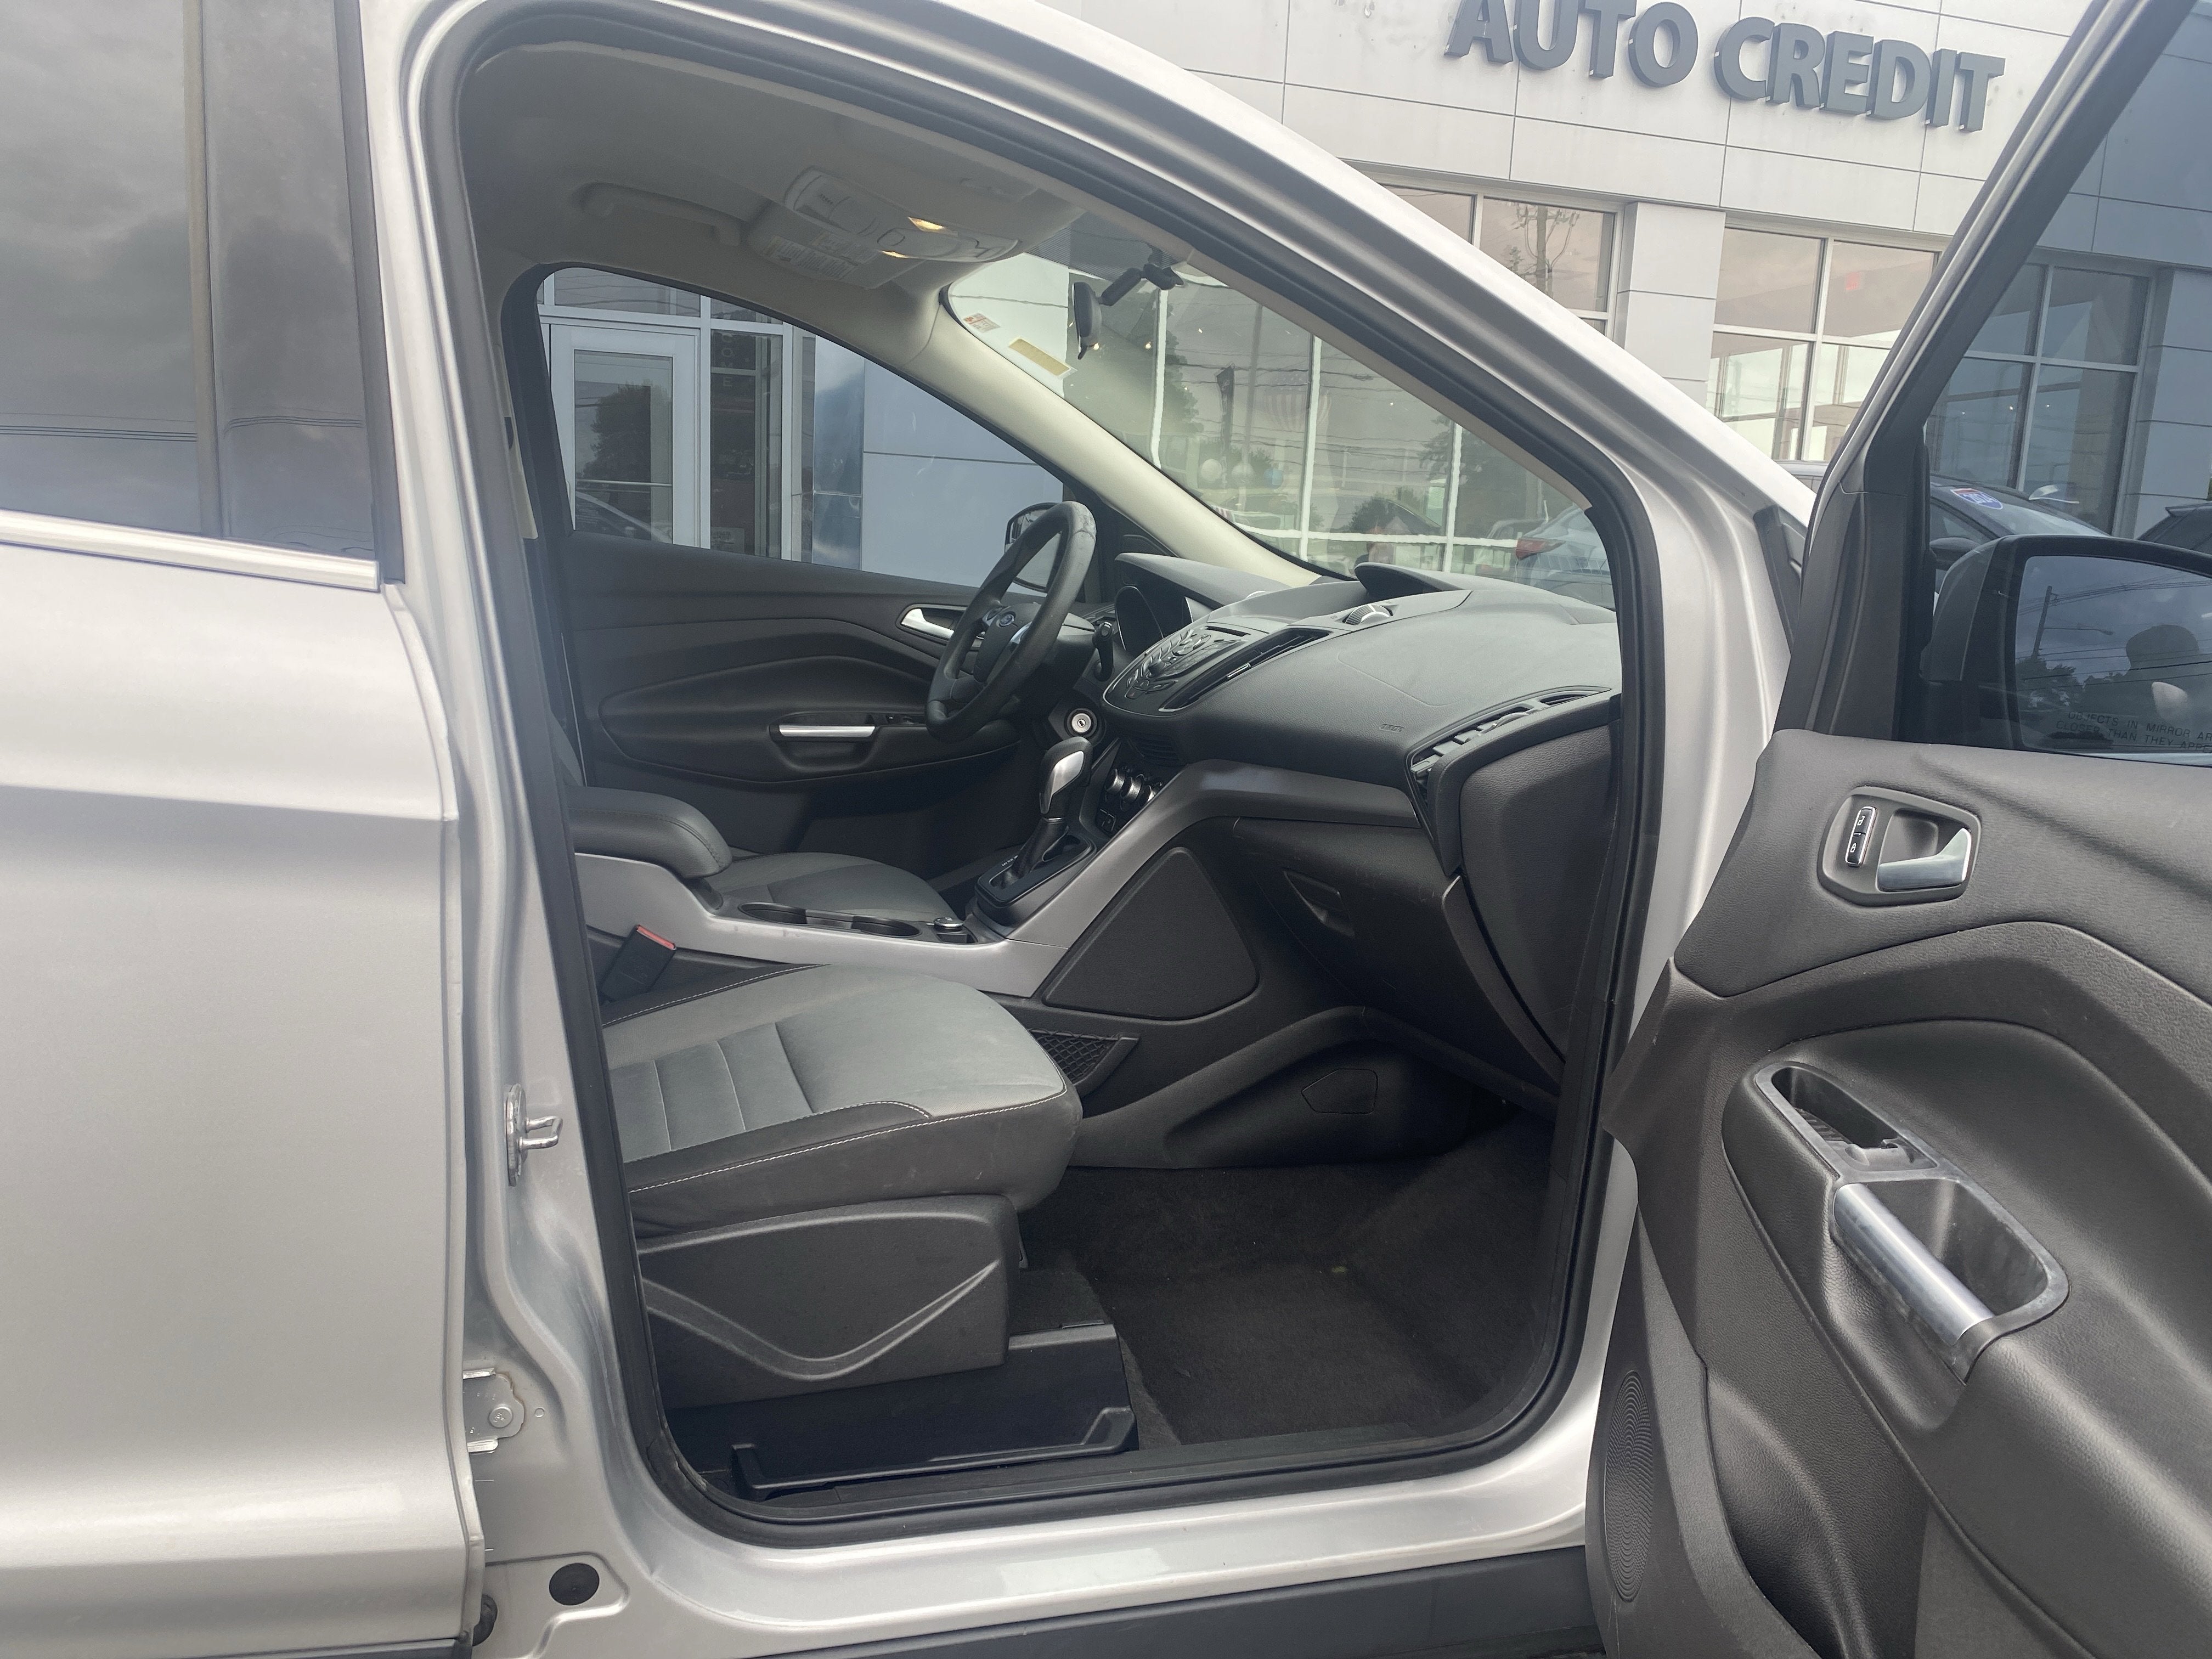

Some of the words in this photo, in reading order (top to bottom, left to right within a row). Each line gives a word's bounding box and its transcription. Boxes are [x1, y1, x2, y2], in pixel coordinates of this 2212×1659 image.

[1444, 0, 1699, 87] AUTO
[1713, 17, 2006, 132] CREDIT
[2056, 720, 2100, 733] CLOSER
[2108, 729, 2137, 741] THAN
[2145, 735, 2173, 747] THEY
[2068, 711, 2119, 726] OBJECTS
[2128, 720, 2138, 729] IN
[2146, 723, 2191, 737] MIRROR
